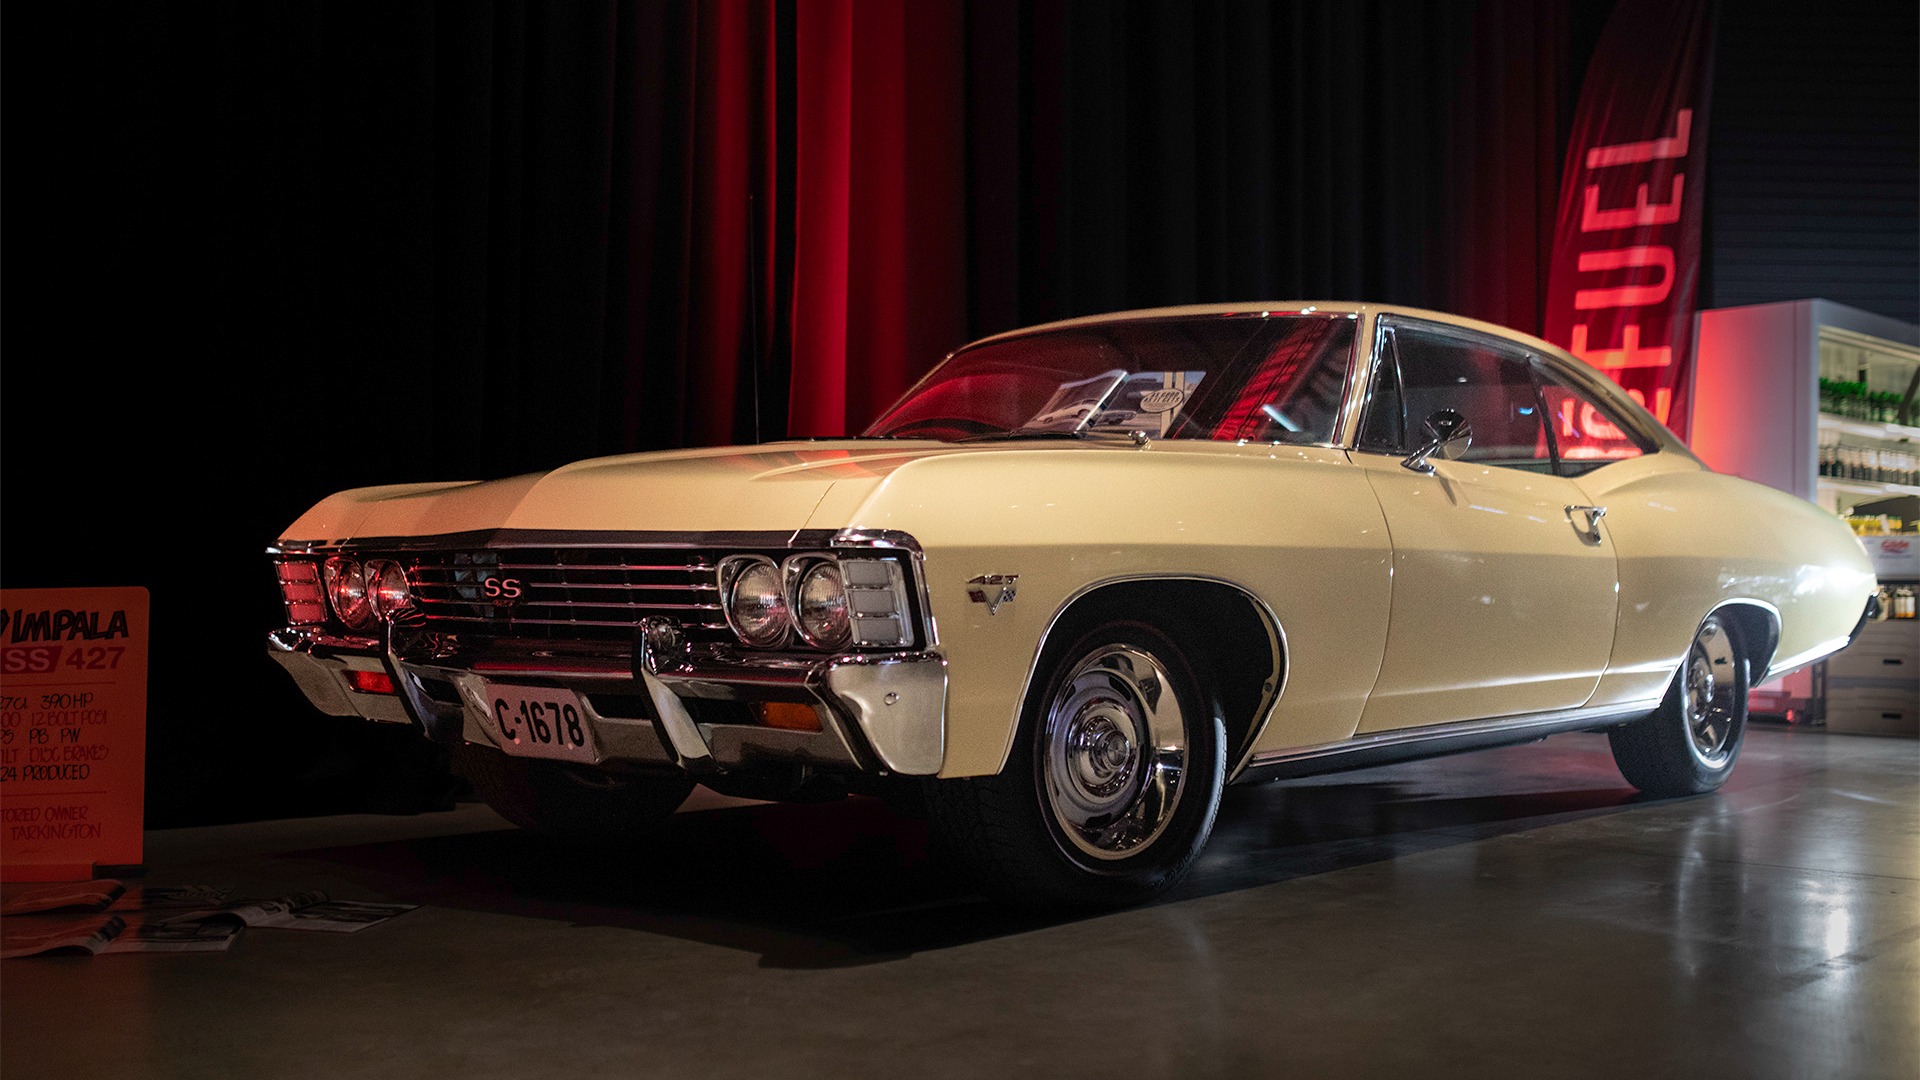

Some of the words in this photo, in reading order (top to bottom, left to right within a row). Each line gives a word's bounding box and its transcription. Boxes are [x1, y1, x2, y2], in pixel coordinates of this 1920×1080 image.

[485, 577, 521, 598] SS
[966, 574, 1020, 585] 427
[11, 609, 129, 643] IMPALA
[4, 648, 50, 673] SS
[66, 646, 125, 670] 427
[495, 698, 585, 747] C-1678
[30, 728, 49, 745] PB
[61, 727, 81, 743] PW
[64, 744, 109, 761] BRAKES
[23, 763, 90, 781] PRODUCED
[45, 805, 88, 822] OWNER
[10, 822, 102, 840] TARKINGTON
